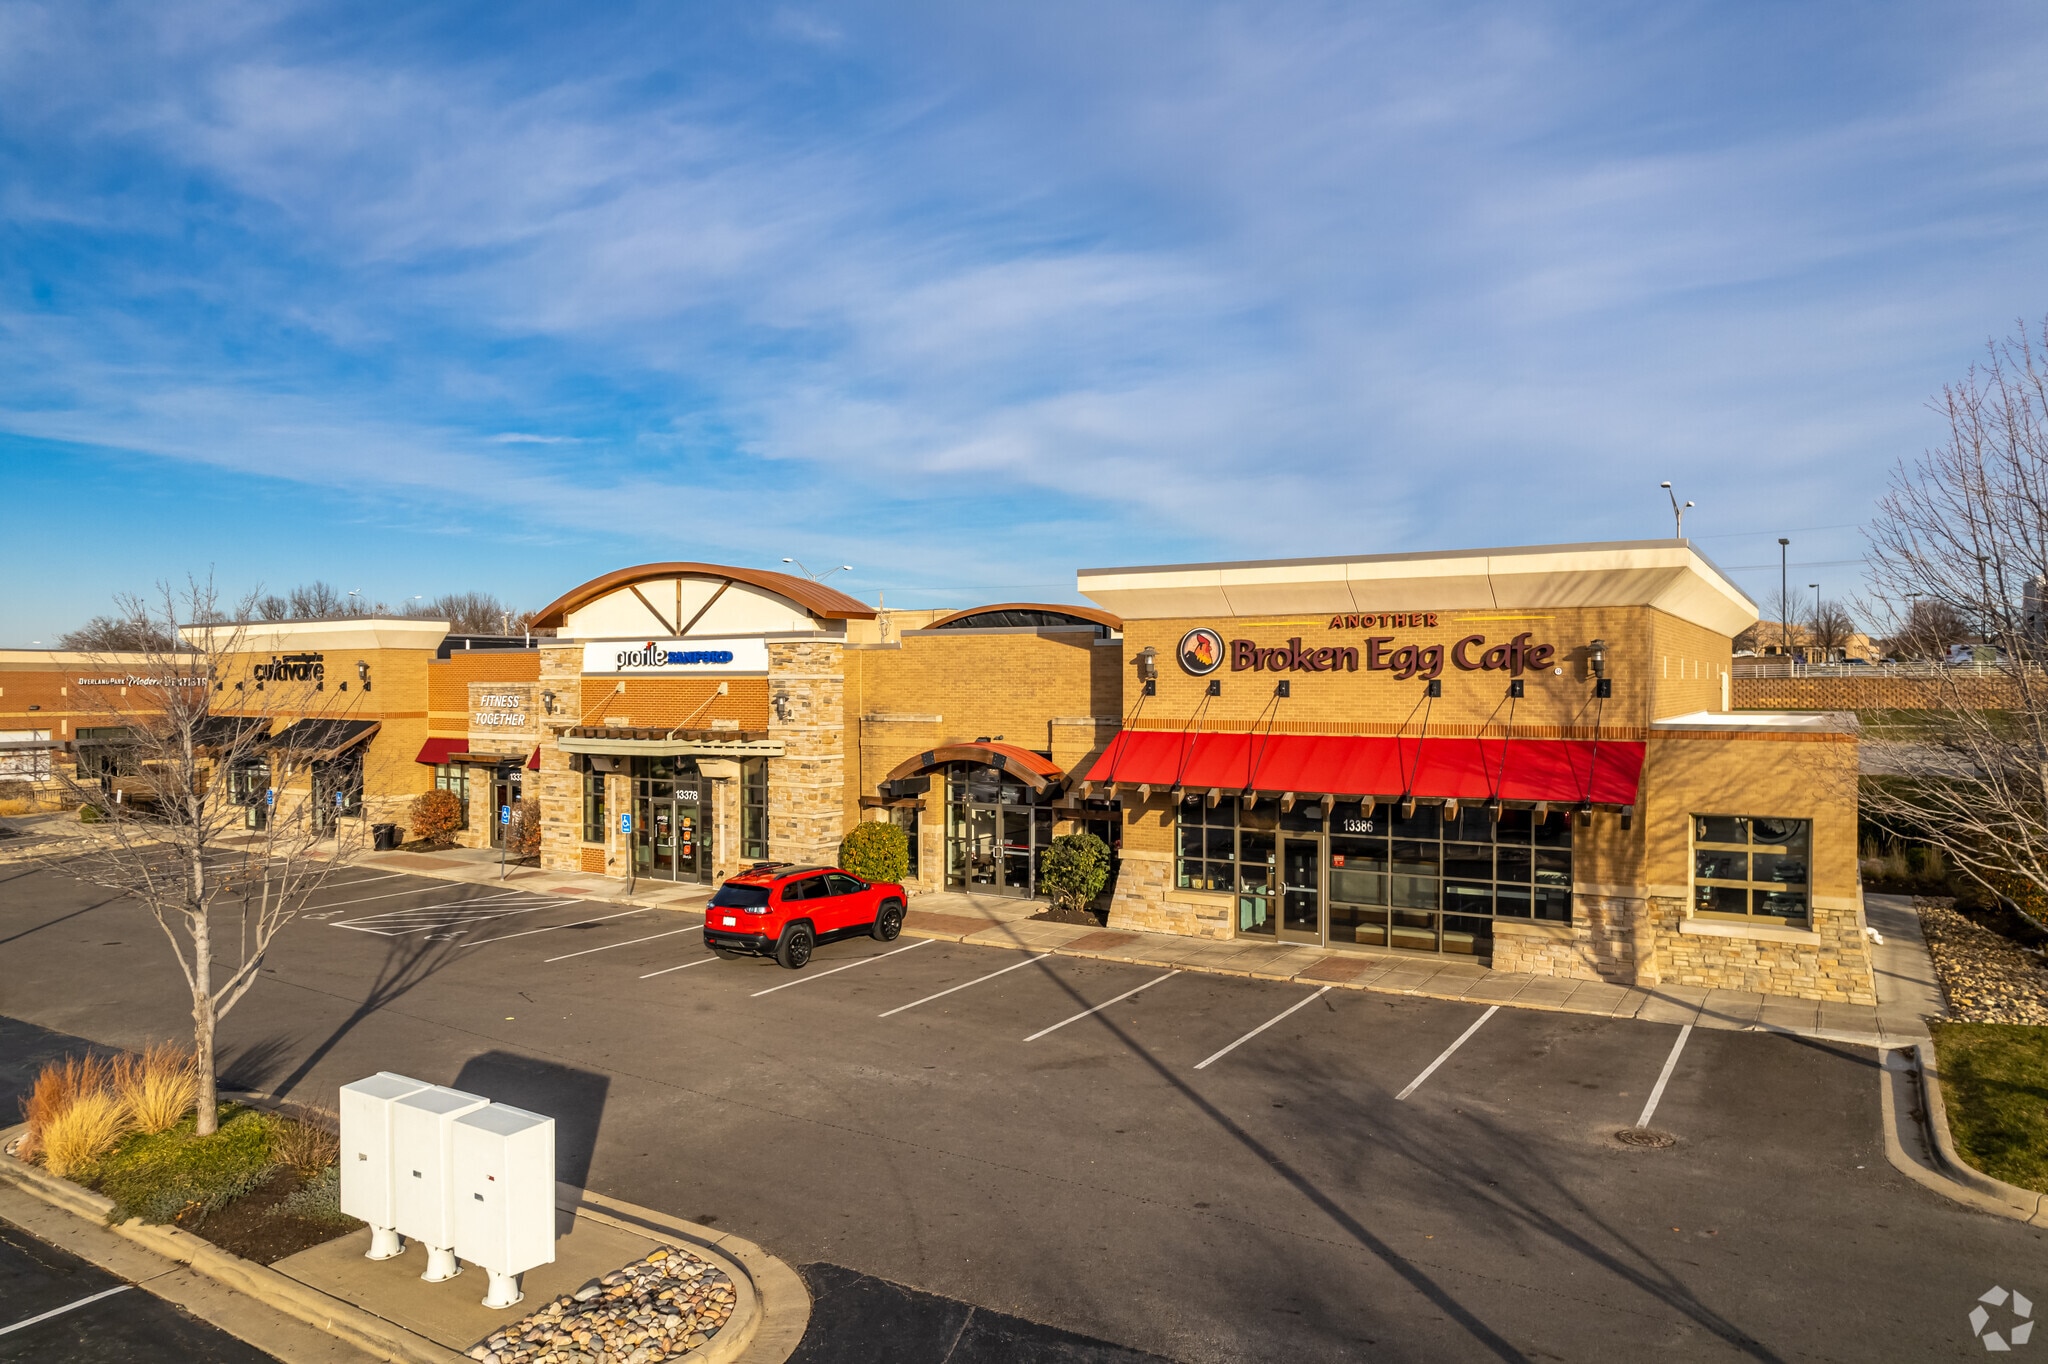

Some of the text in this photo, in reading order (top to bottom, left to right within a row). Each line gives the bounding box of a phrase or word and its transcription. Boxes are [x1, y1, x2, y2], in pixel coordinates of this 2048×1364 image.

[1329, 612, 1439, 629] ANOTHER
[616, 641, 667, 671] profile
[1231, 631, 1555, 680] Broken Egg Cafe
[79, 677, 110, 686] OVERLAND
[110, 677, 125, 686] PARK
[126, 675, 161, 687] Modern
[480, 695, 519, 708] FITNESS
[476, 712, 525, 726] TOGETHER
[676, 790, 698, 801] 13378
[1343, 818, 1374, 833] 13386
